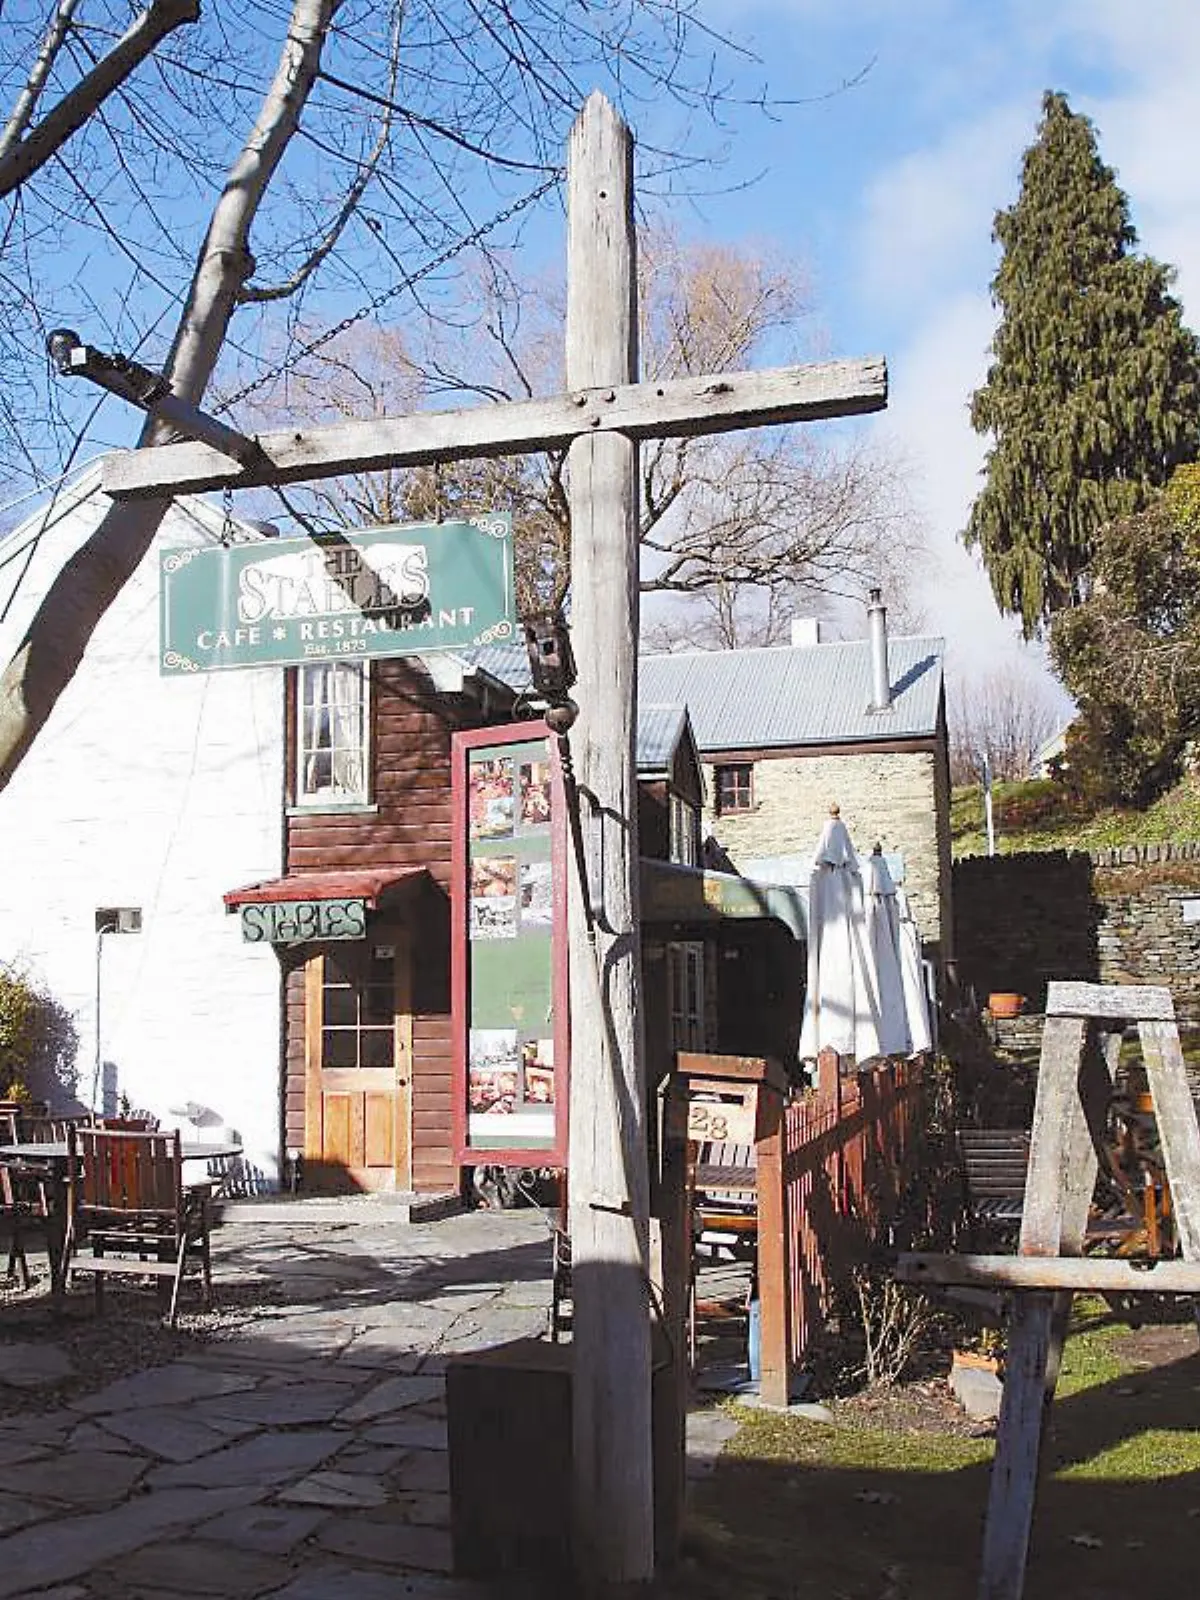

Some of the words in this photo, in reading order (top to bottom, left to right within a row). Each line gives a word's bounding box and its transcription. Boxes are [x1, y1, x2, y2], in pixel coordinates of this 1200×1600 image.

[301, 549, 363, 577] THE
[241, 552, 428, 620] STABLES
[197, 629, 261, 650] CAFE
[300, 606, 475, 641] RESTAURANT
[242, 901, 365, 942] STABLES
[689, 1106, 729, 1140] 28
